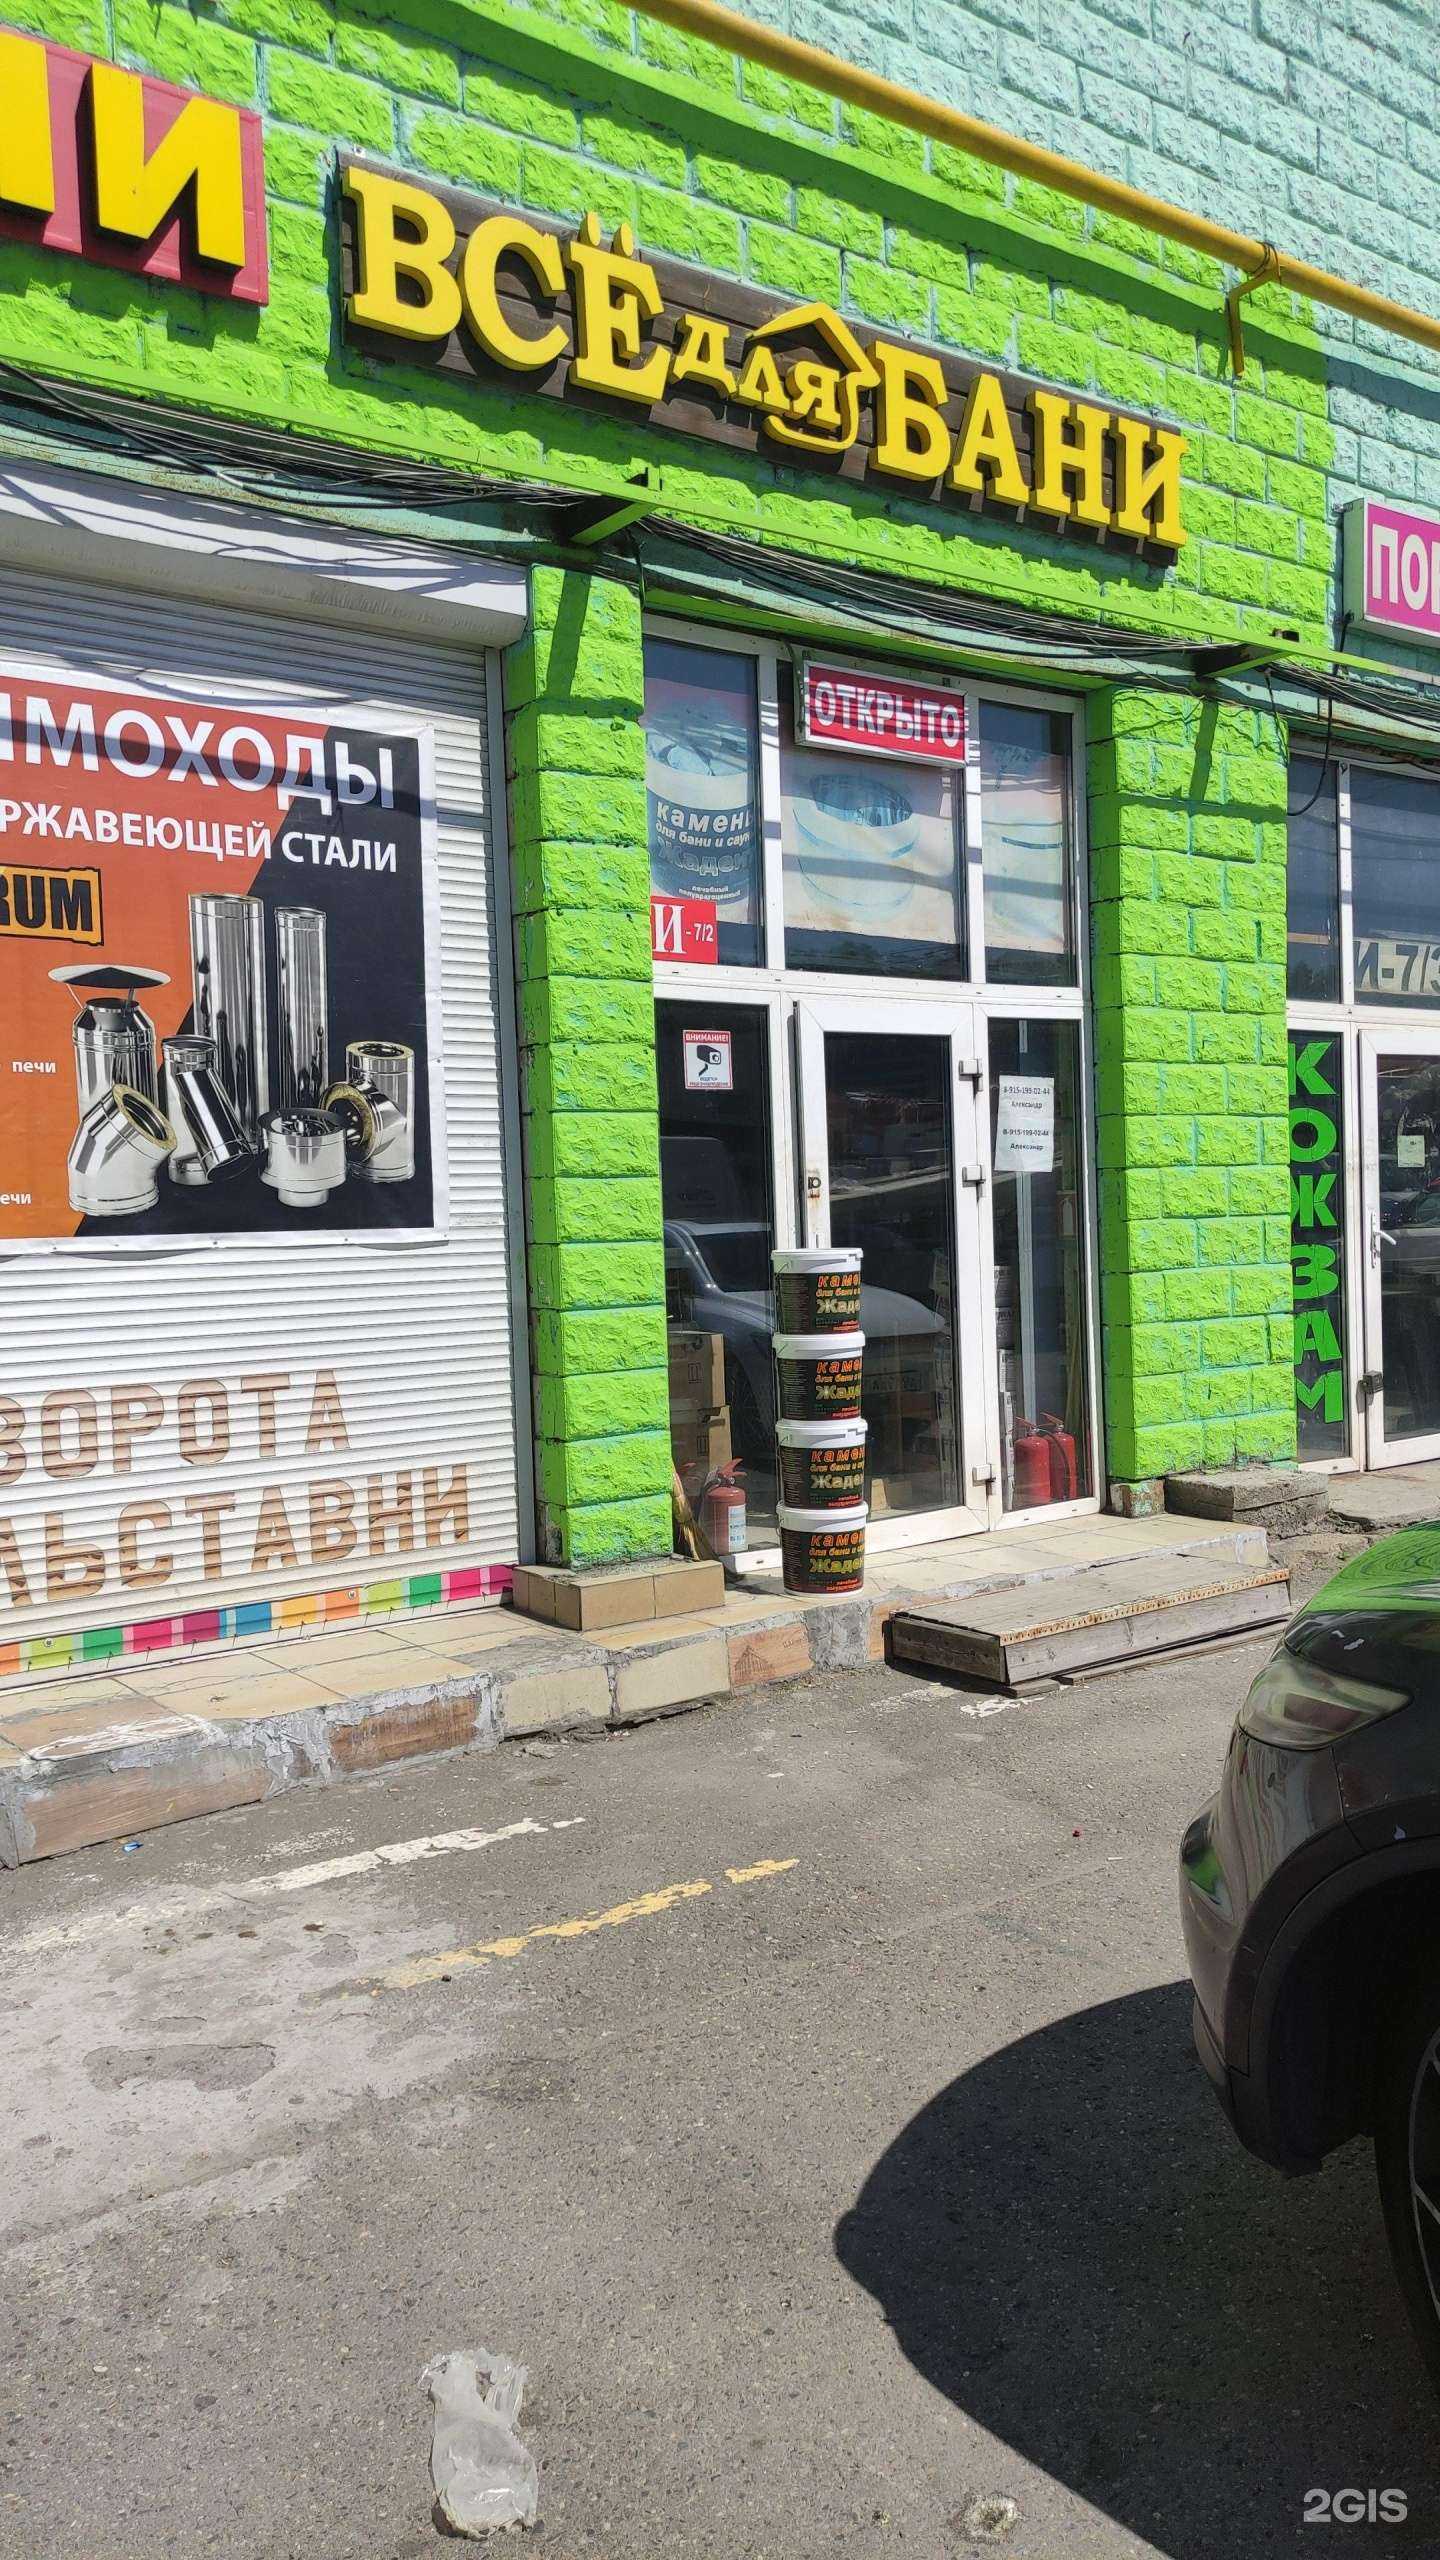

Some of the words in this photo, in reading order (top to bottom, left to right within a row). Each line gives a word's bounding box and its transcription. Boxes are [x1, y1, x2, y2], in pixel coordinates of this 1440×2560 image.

[345, 166, 671, 401] ВСЁ
[673, 312, 842, 429] для
[868, 340, 1189, 549] БАНИ
[1372, 523, 1440, 616] ПО
[815, 681, 960, 748] ОТКРЫТО
[281, 831, 397, 873] СТАЛИ
[679, 832, 711, 848] бани
[715, 838, 723, 848] и
[12, 1061, 56, 1073] печи
